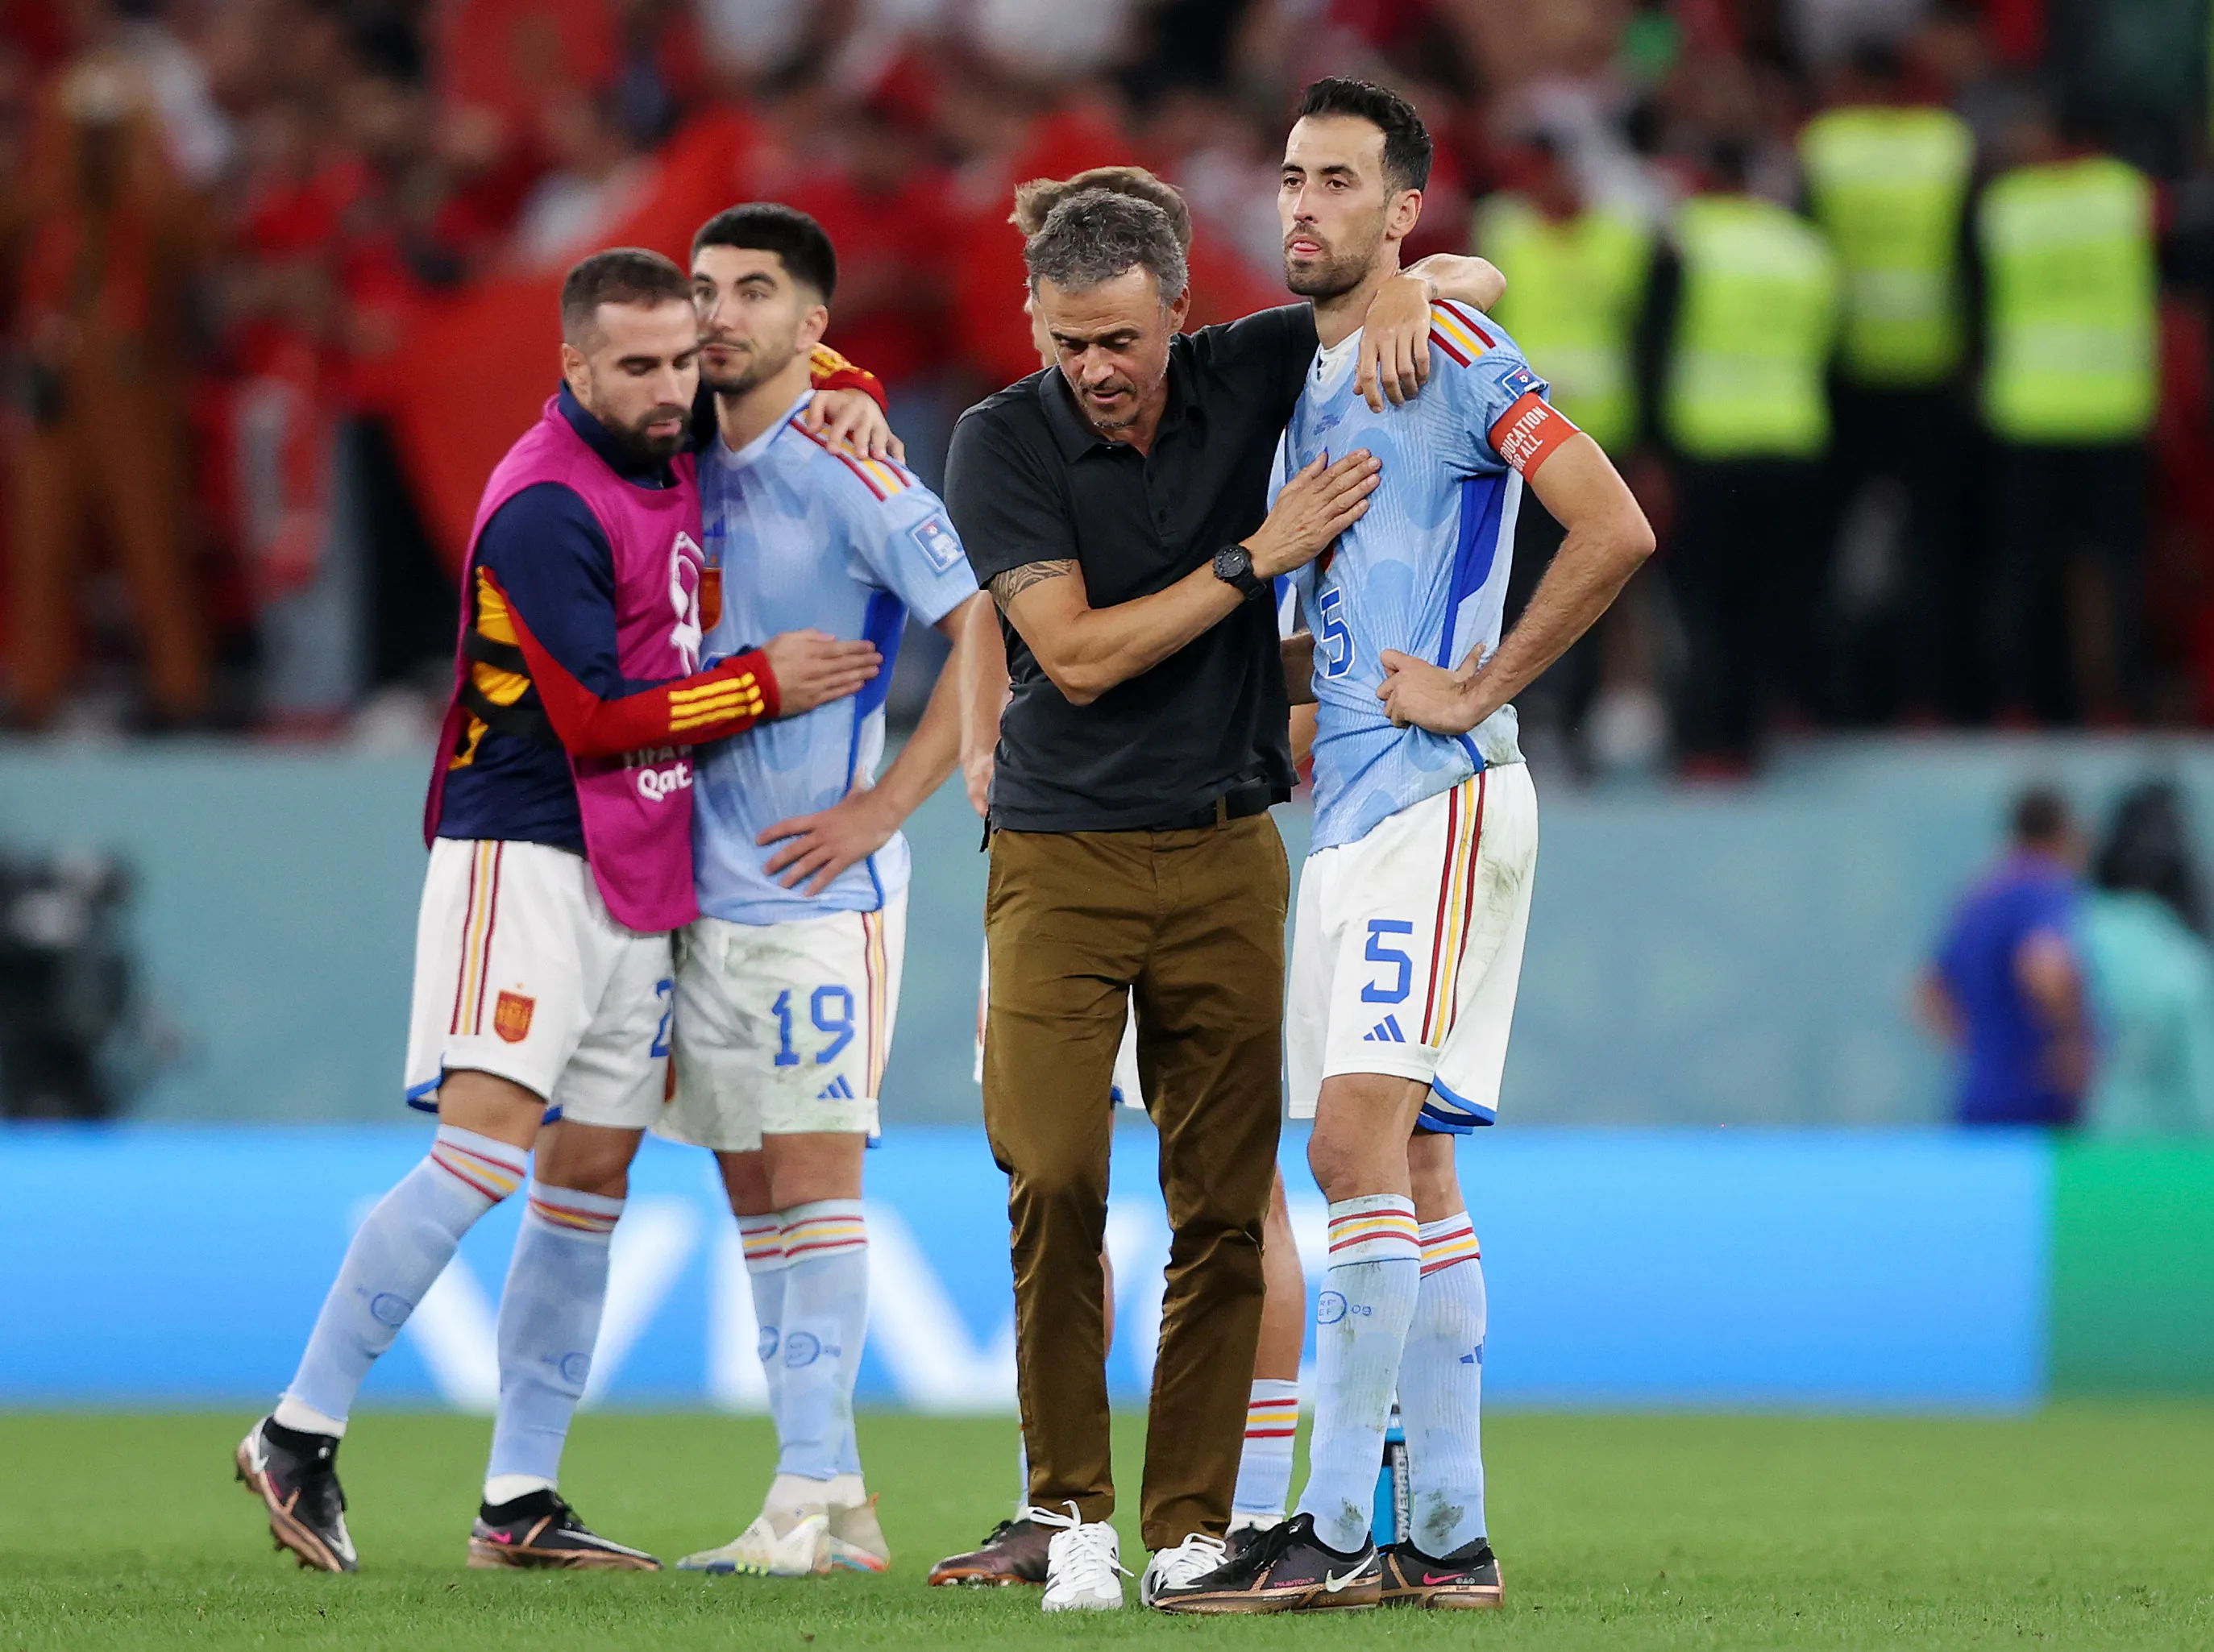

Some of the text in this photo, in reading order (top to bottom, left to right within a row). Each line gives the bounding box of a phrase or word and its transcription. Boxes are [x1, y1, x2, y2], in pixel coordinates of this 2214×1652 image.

[1499, 405, 1550, 464] EDUCATION
[1519, 434, 1544, 459] ALL
[1319, 586, 1356, 679] 5
[1360, 919, 1413, 1004] 5
[771, 985, 854, 1066] 19
